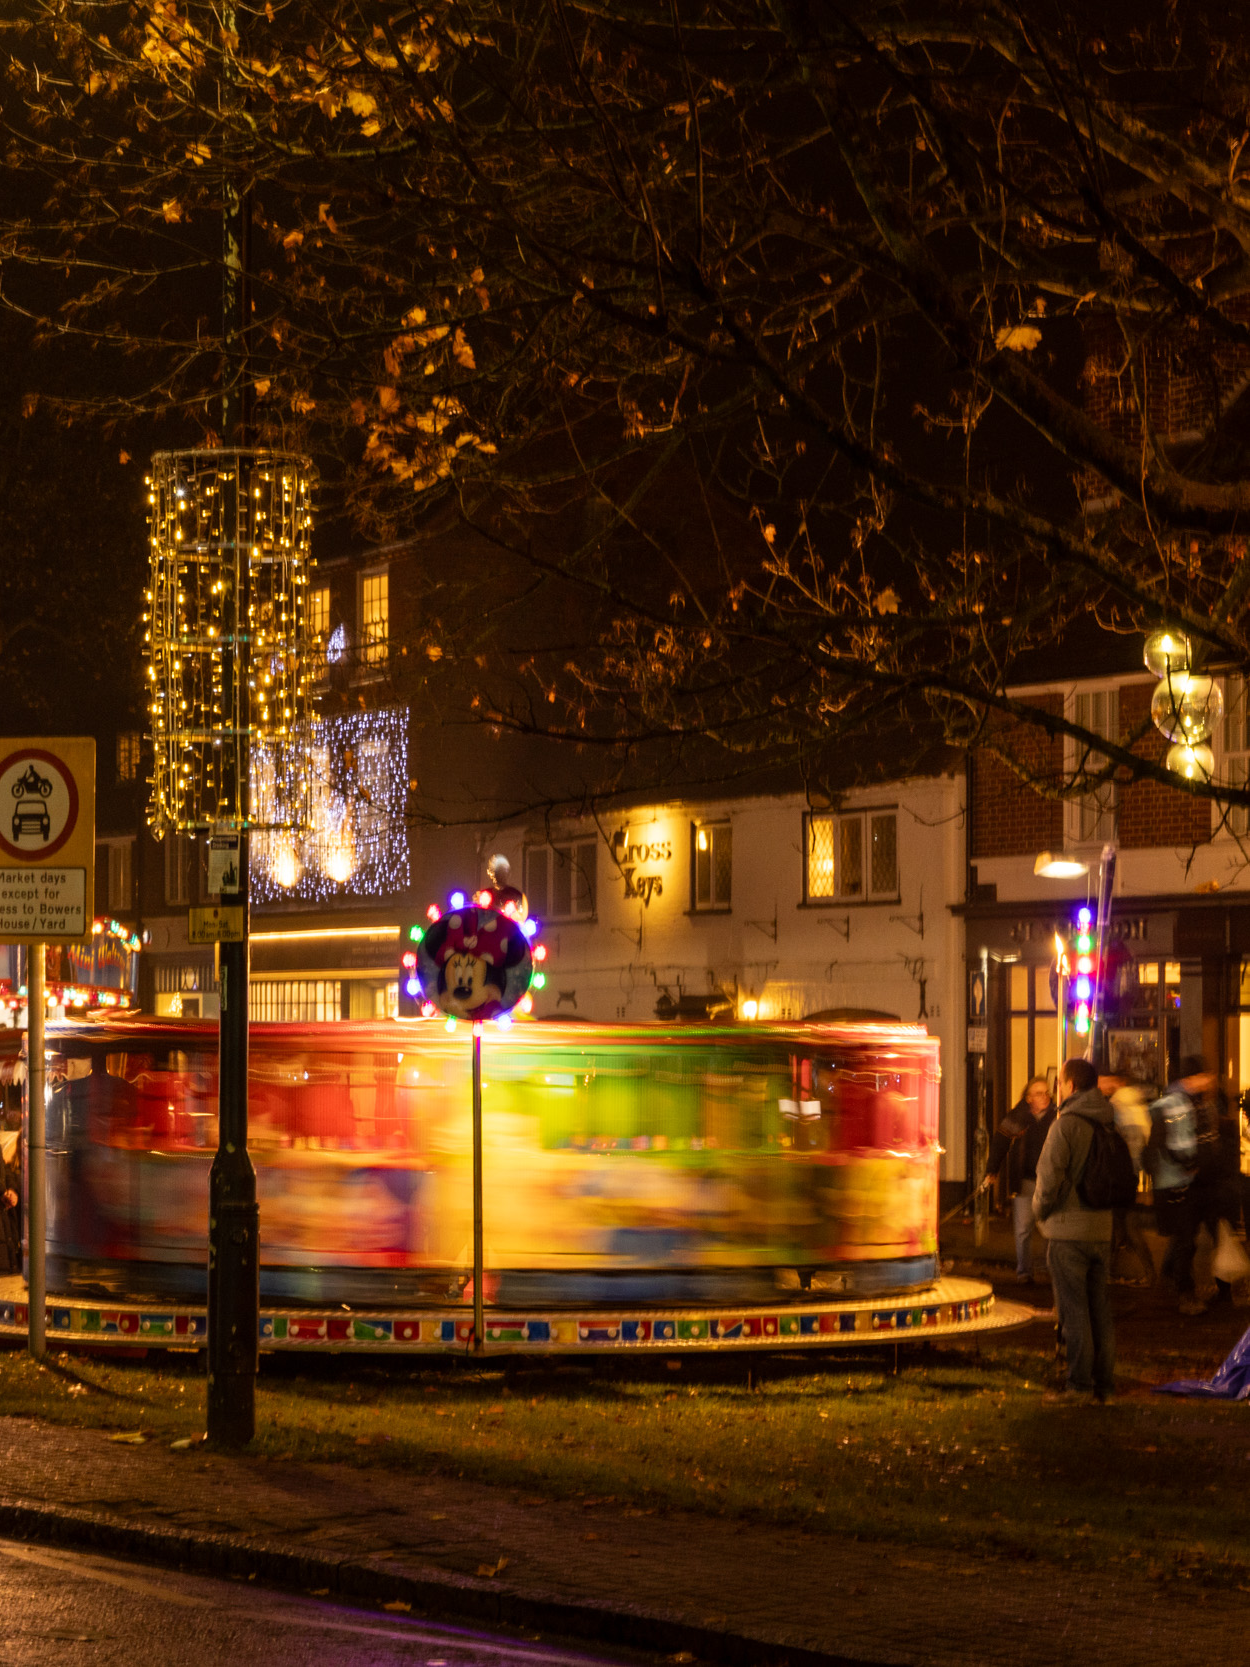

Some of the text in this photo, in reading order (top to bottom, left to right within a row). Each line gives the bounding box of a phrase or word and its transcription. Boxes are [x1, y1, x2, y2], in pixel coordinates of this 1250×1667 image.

[612, 836, 672, 865] Cross
[40, 871, 66, 885] days
[1, 888, 60, 900] except for
[623, 867, 663, 908] Keys
[22, 904, 34, 914] to
[39, 904, 82, 915] Bowers
[40, 918, 66, 929] Yard
